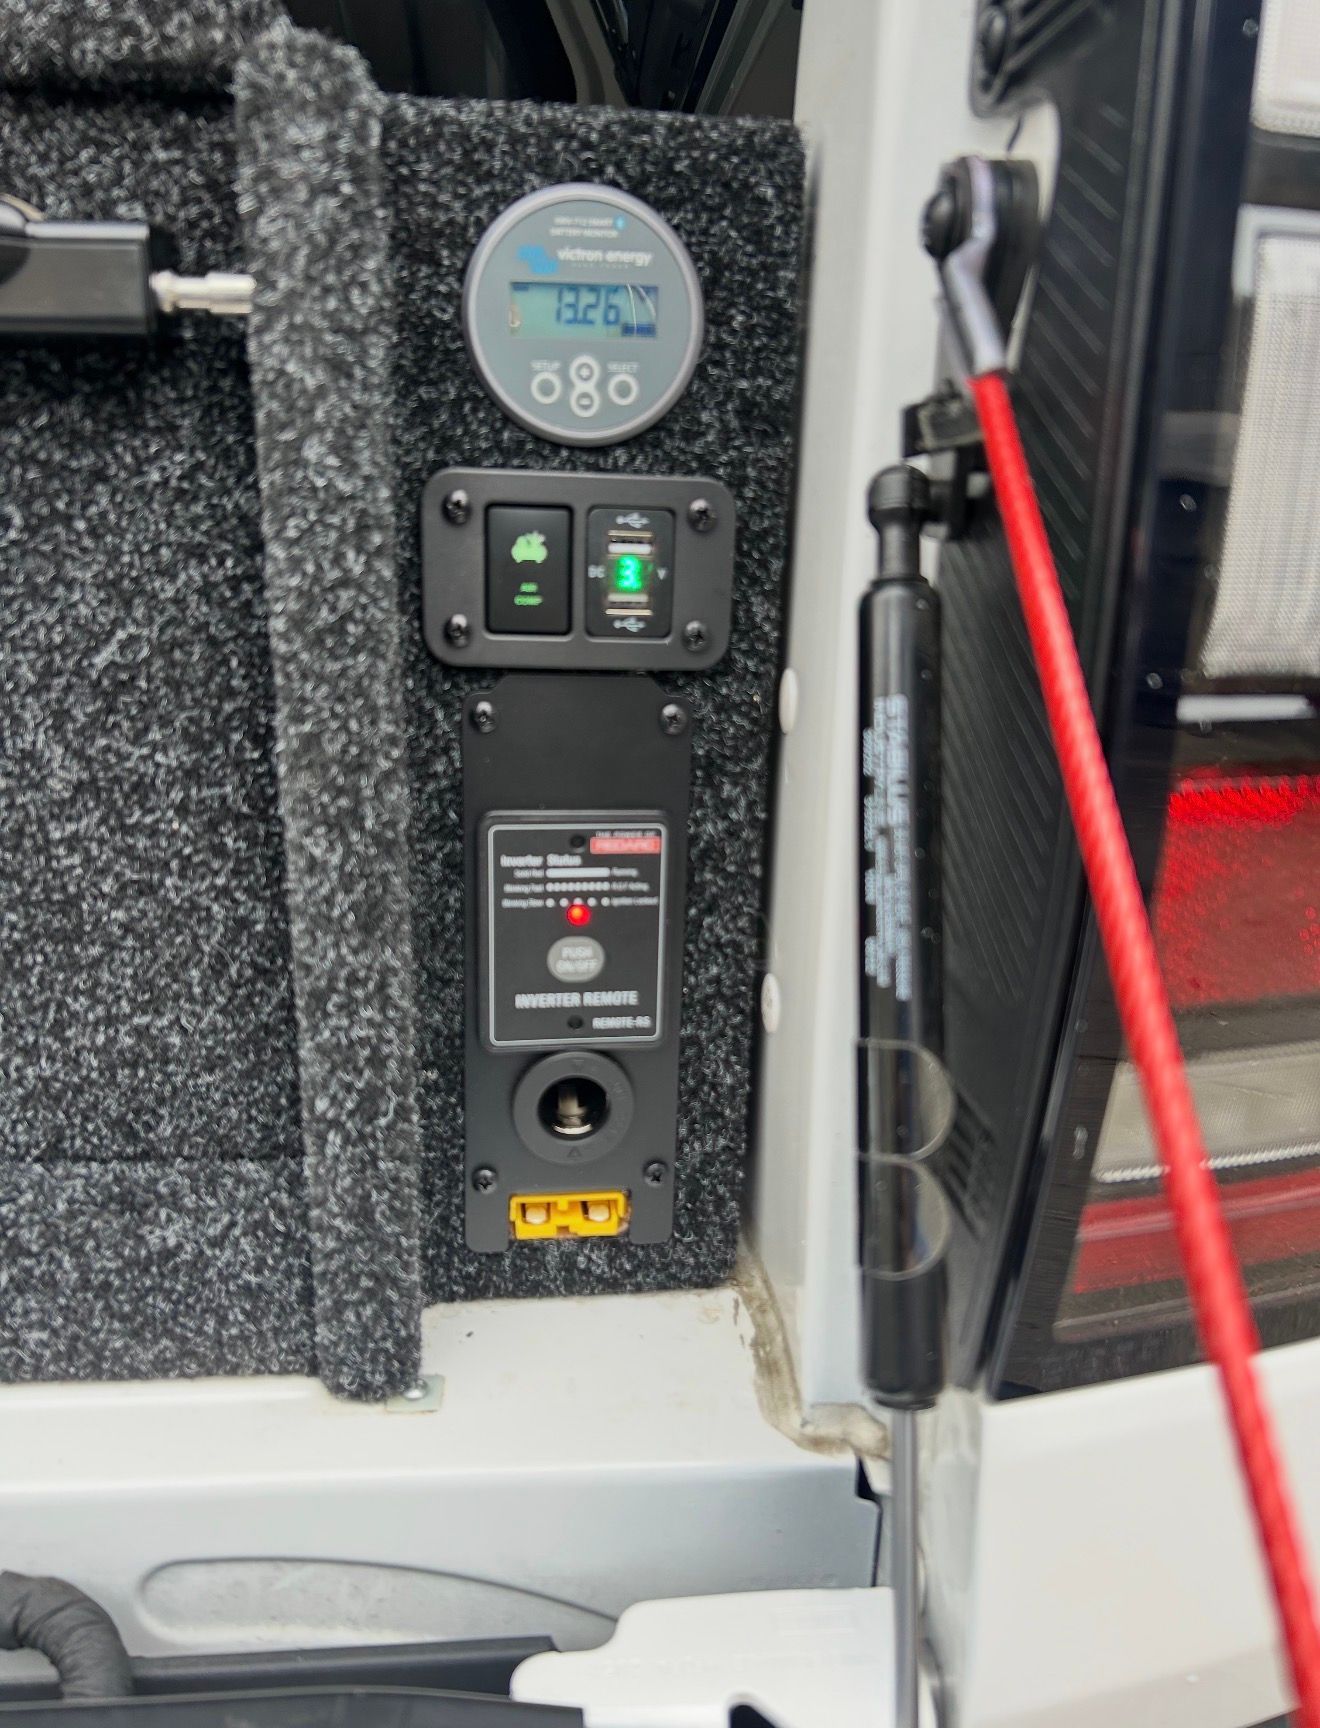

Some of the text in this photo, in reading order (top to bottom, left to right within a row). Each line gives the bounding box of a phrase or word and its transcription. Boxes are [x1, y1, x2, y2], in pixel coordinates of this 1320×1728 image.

[557, 246, 604, 262] victron
[605, 249, 653, 267] energy
[500, 854, 582, 868] Inverter Status
[515, 991, 639, 1009] INVERTER REMOTE
